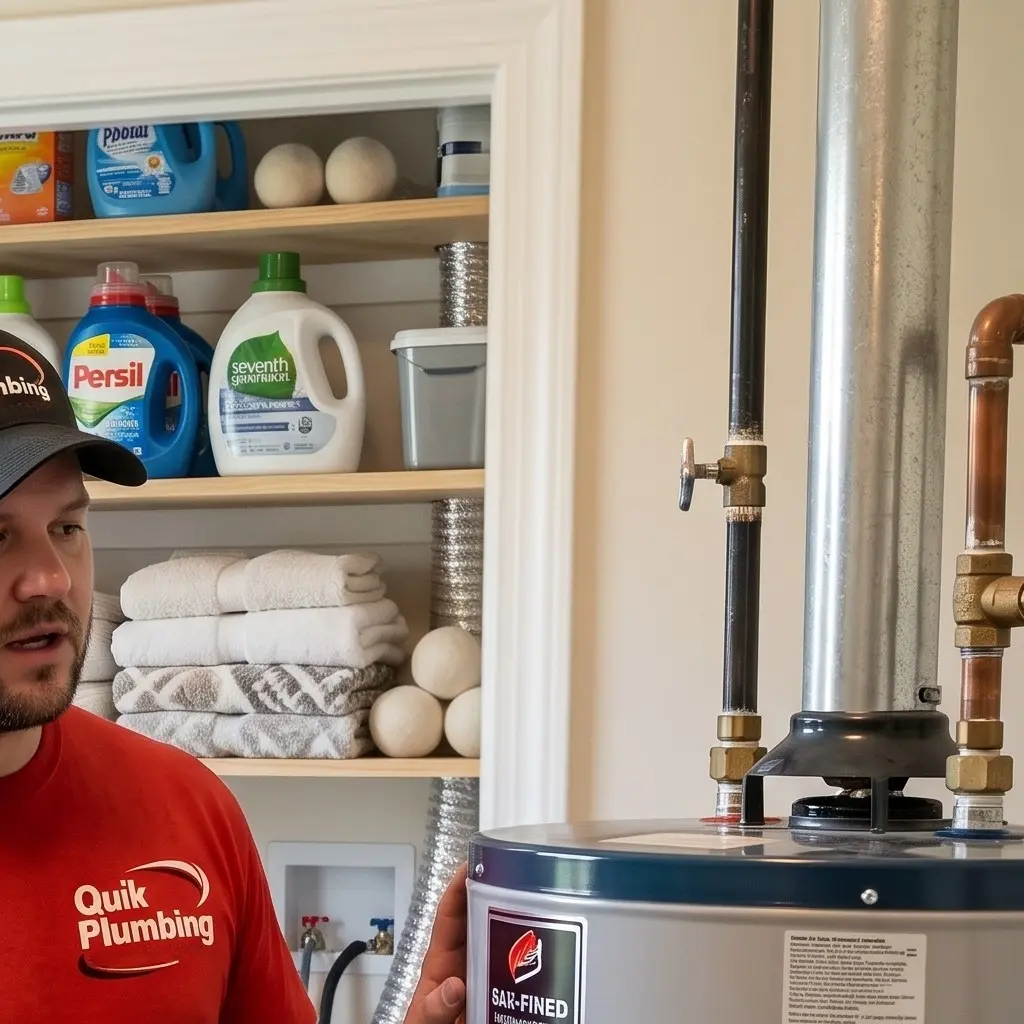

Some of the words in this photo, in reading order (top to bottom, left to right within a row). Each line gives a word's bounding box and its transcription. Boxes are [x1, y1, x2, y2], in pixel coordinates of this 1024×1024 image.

[73, 361, 143, 389] Persil
[232, 357, 289, 375] seventh
[74, 879, 150, 916] Quik
[78, 909, 215, 950] Plumbing
